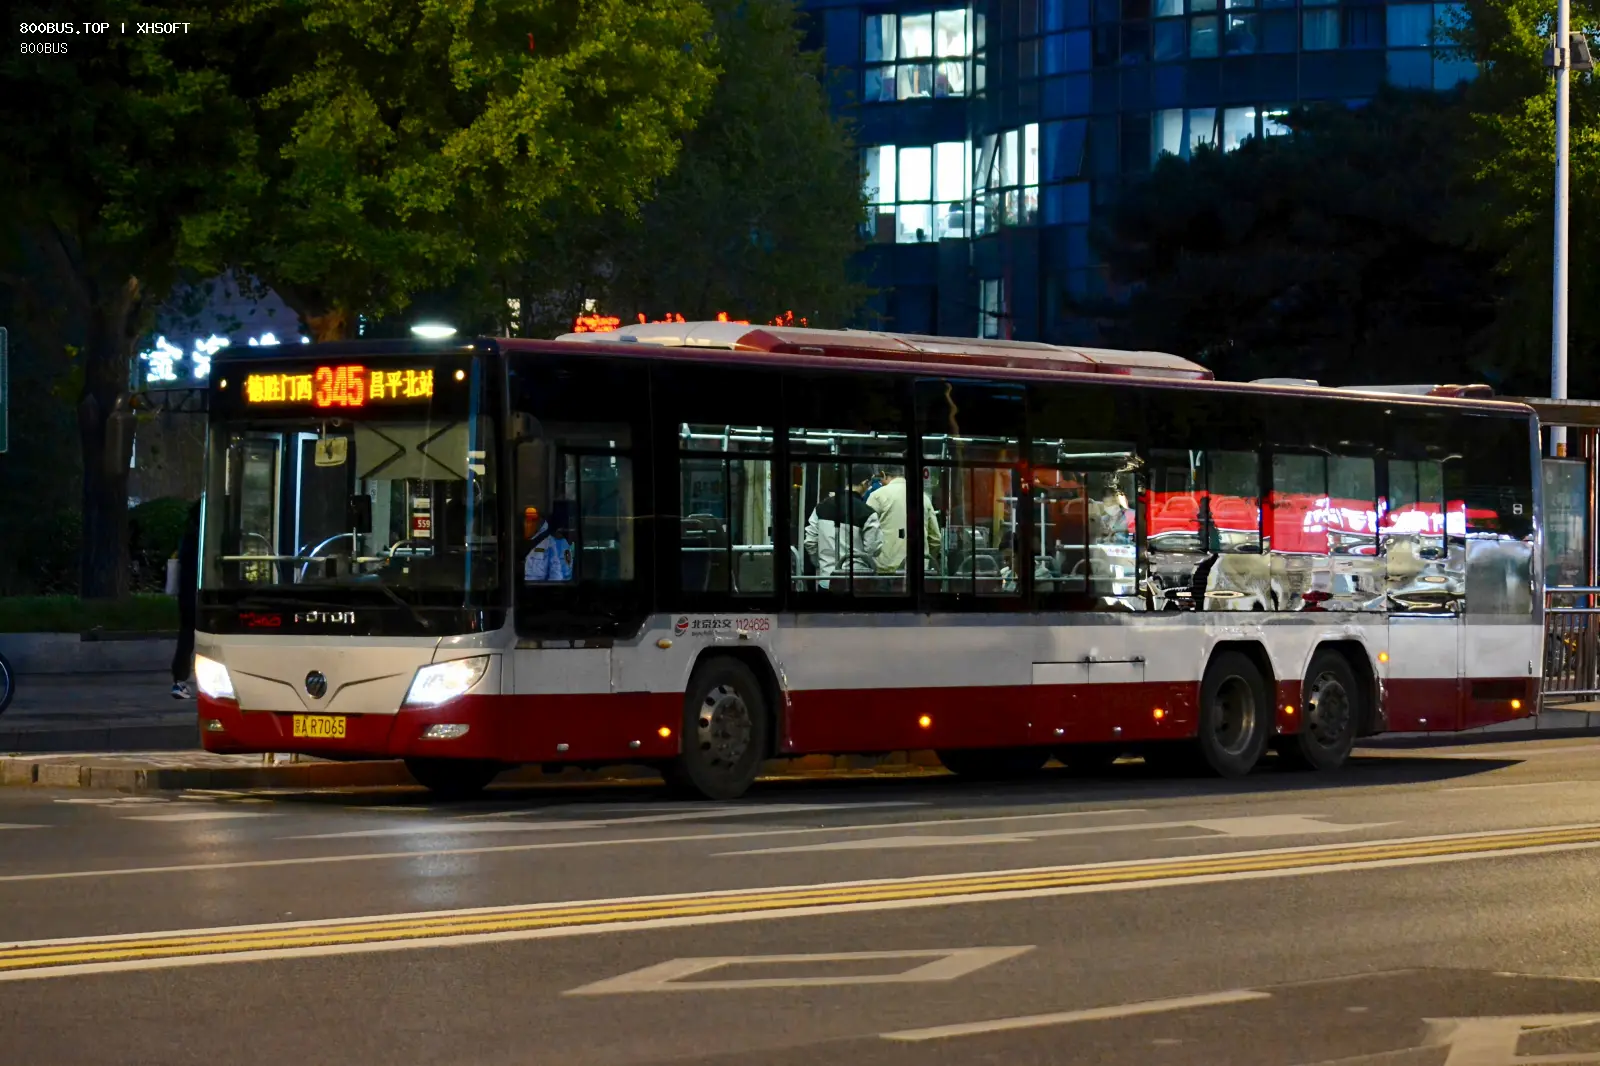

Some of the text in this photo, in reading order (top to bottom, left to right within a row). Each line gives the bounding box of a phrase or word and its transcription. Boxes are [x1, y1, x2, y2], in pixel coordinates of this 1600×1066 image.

[316, 366, 364, 407] 345
[370, 369, 434, 399] 昌平北站
[691, 618, 770, 631] 北京公交 1124625
